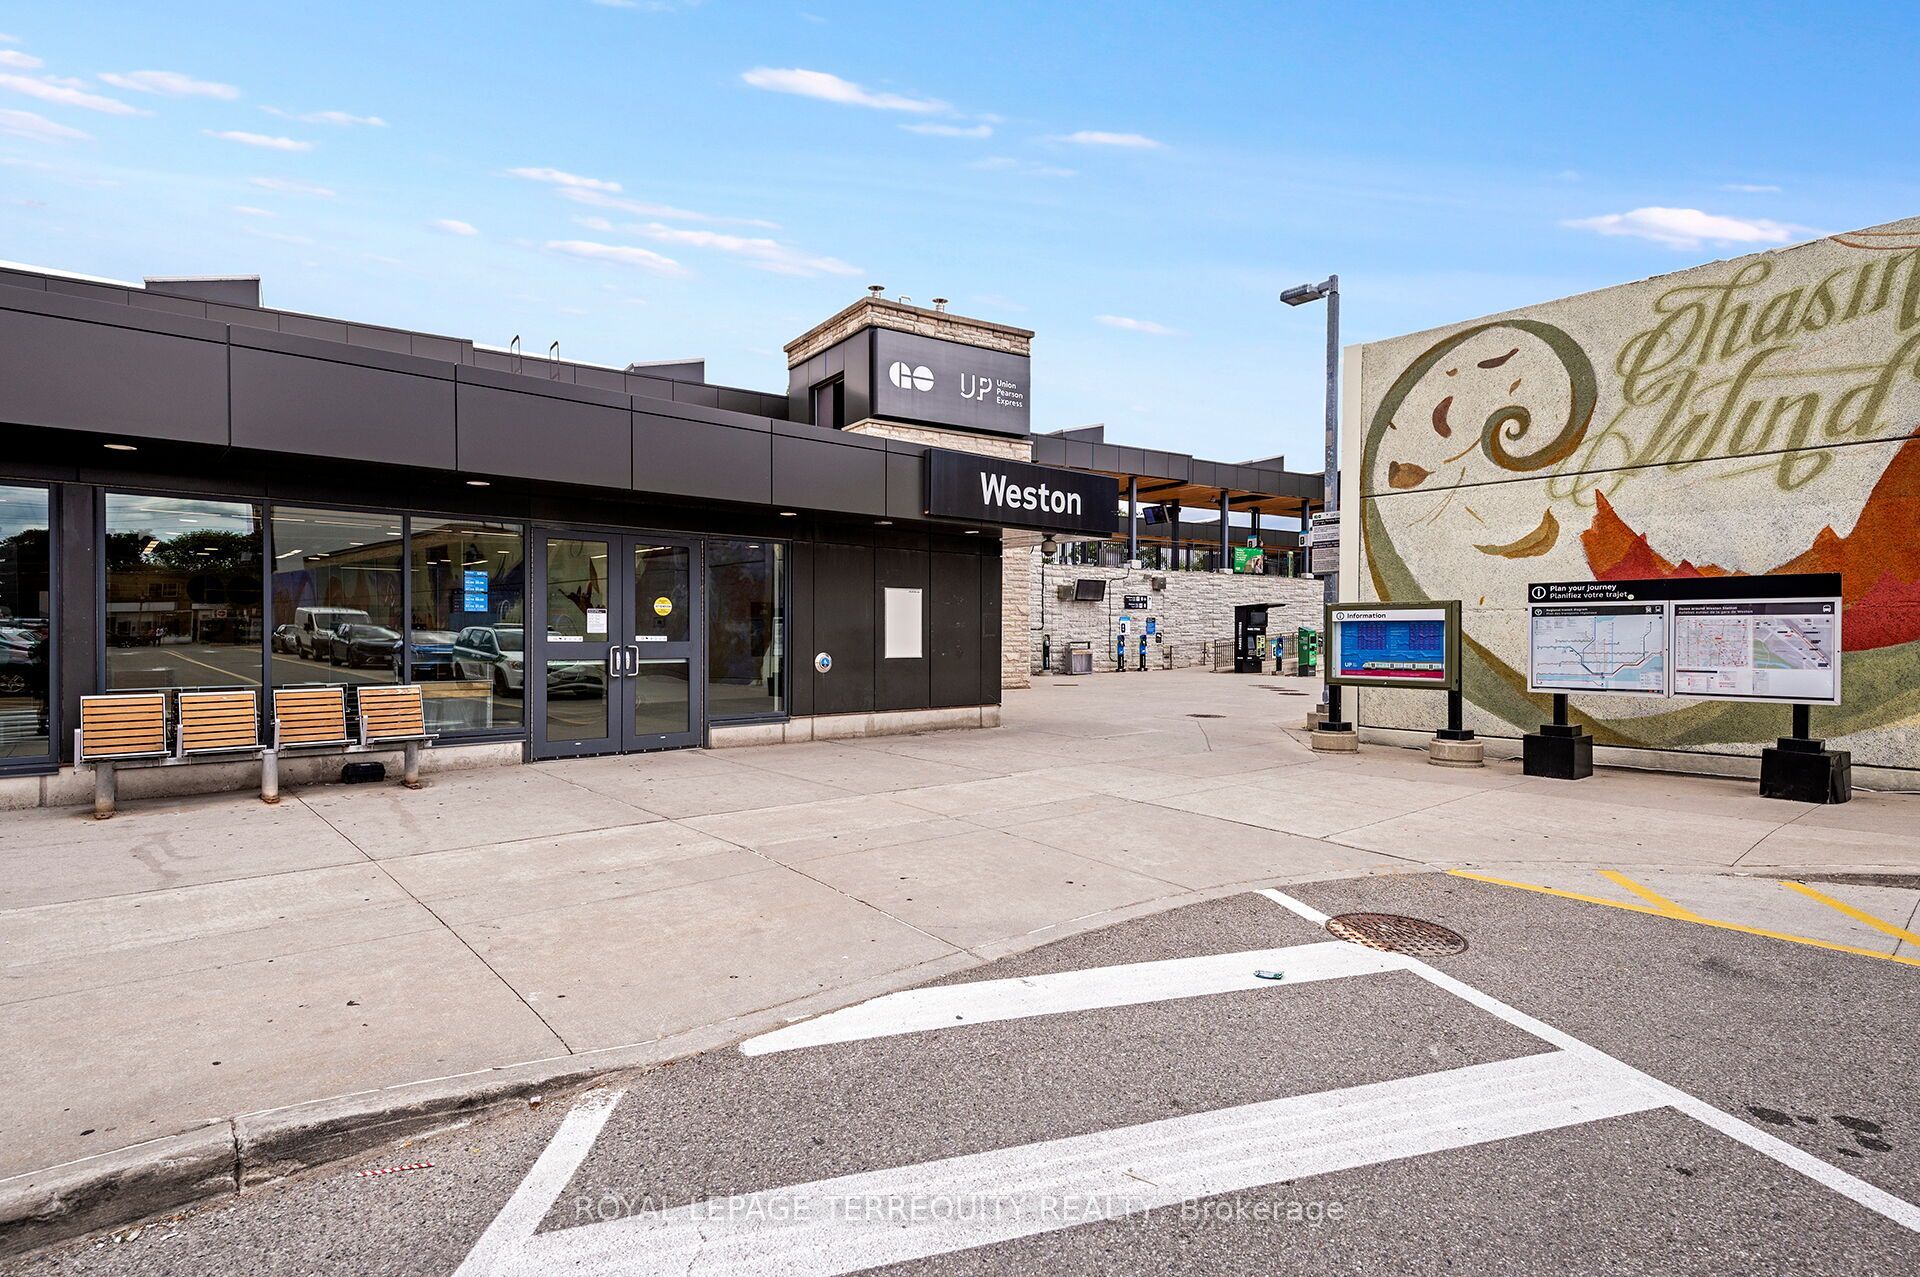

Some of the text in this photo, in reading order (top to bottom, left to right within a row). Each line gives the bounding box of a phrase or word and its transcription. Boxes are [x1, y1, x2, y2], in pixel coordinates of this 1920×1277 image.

[888, 361, 934, 392] GO
[960, 372, 993, 401] UP
[996, 379, 1017, 390] Union
[996, 388, 1024, 400] Pearson
[996, 396, 1023, 408] Express
[980, 472, 1082, 515] Weston
[1587, 584, 1617, 592] journey
[1606, 590, 1628, 600] trajet
